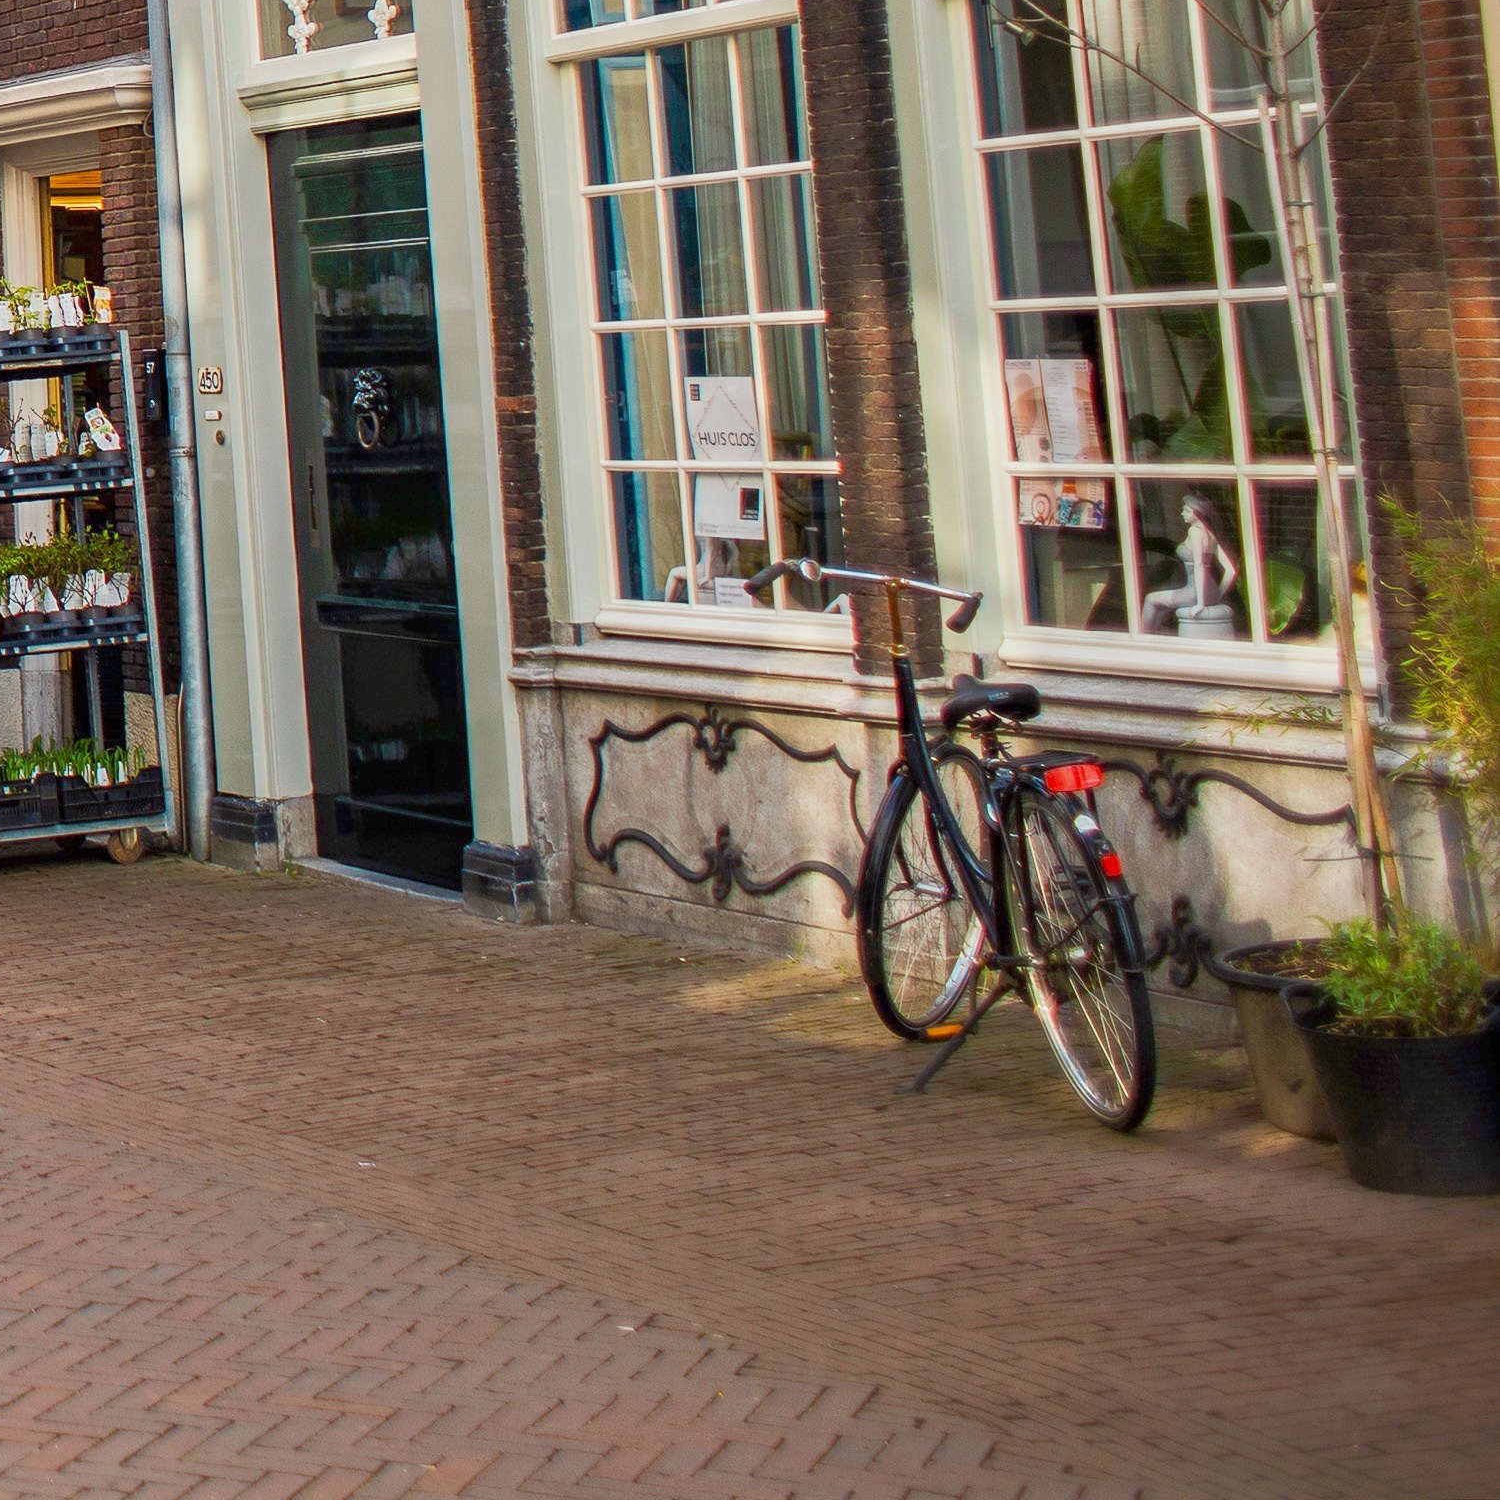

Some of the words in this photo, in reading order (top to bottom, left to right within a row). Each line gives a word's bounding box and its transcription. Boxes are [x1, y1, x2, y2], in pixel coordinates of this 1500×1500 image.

[146, 361, 155, 374] 57
[200, 371, 219, 389] 450
[698, 430, 727, 446] HUIS
[727, 431, 756, 447] CLOS
